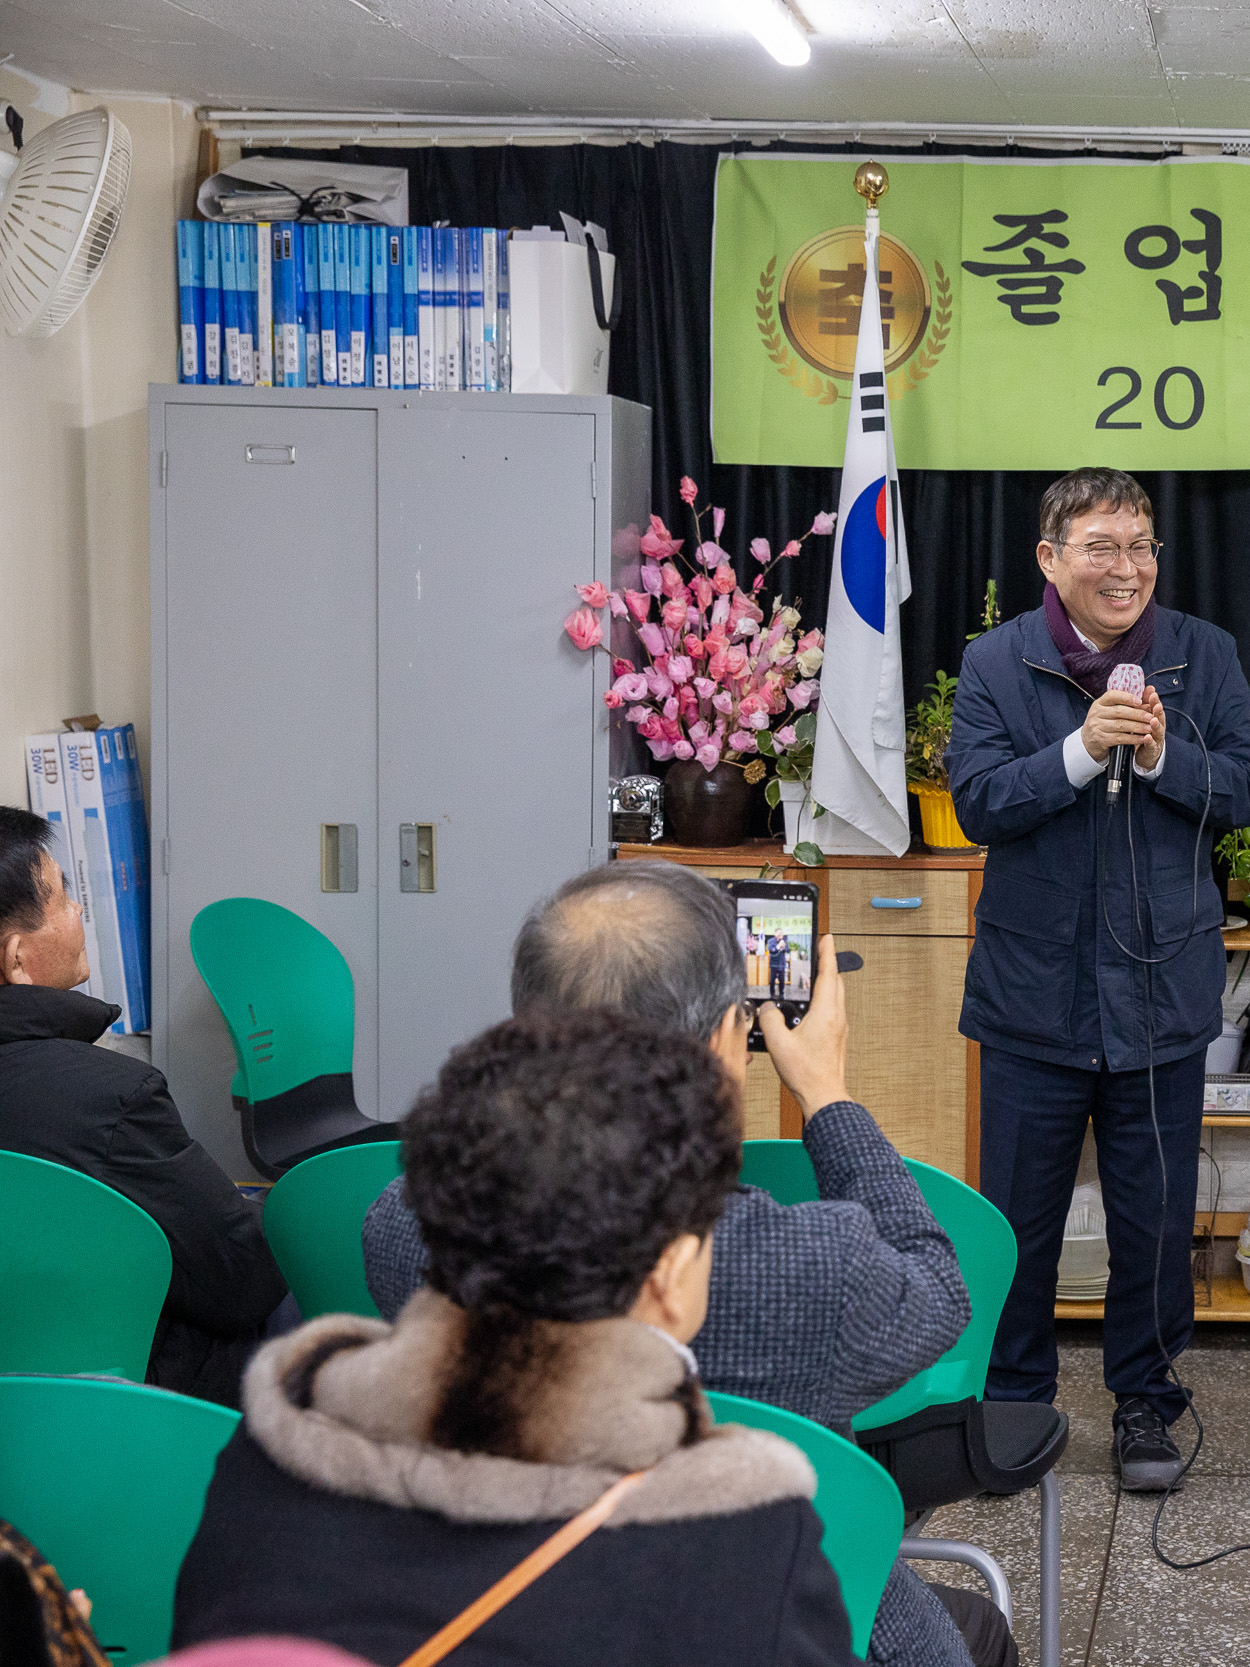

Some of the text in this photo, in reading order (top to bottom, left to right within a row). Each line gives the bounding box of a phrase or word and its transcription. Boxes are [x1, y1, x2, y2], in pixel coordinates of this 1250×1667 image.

[1095, 366, 1205, 430] 20
[30, 748, 43, 775] 30W
[42, 748, 58, 784] LED
[66, 745, 80, 771] 30W
[79, 745, 95, 781] LED
